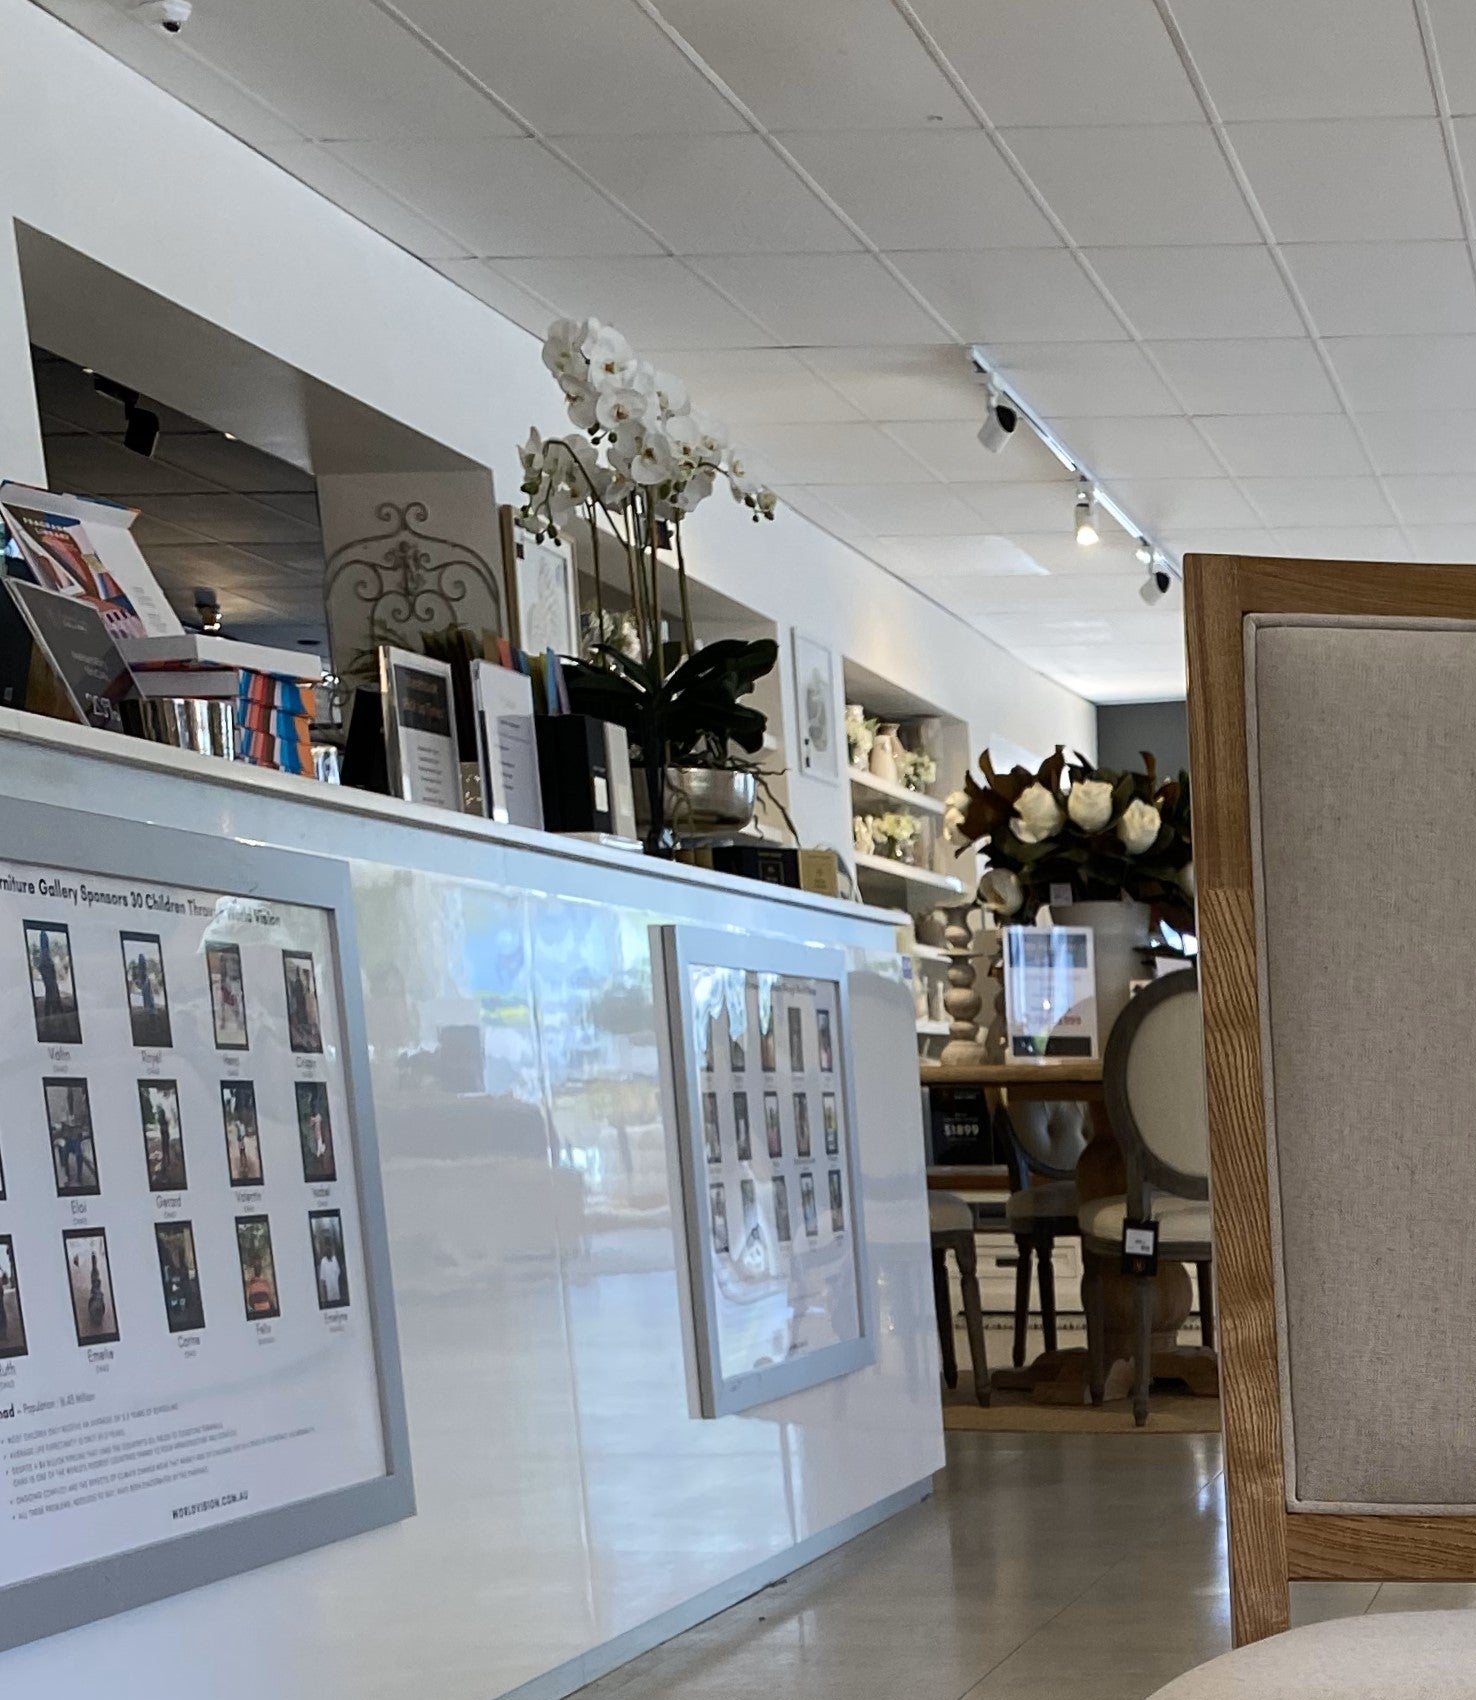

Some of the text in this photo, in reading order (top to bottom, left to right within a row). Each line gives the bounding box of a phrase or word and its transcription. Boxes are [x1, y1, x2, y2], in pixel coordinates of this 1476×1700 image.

[38, 878, 78, 906] Gallery
[80, 884, 129, 908] Sponsors
[130, 890, 144, 908] 30
[145, 893, 186, 915] Children
